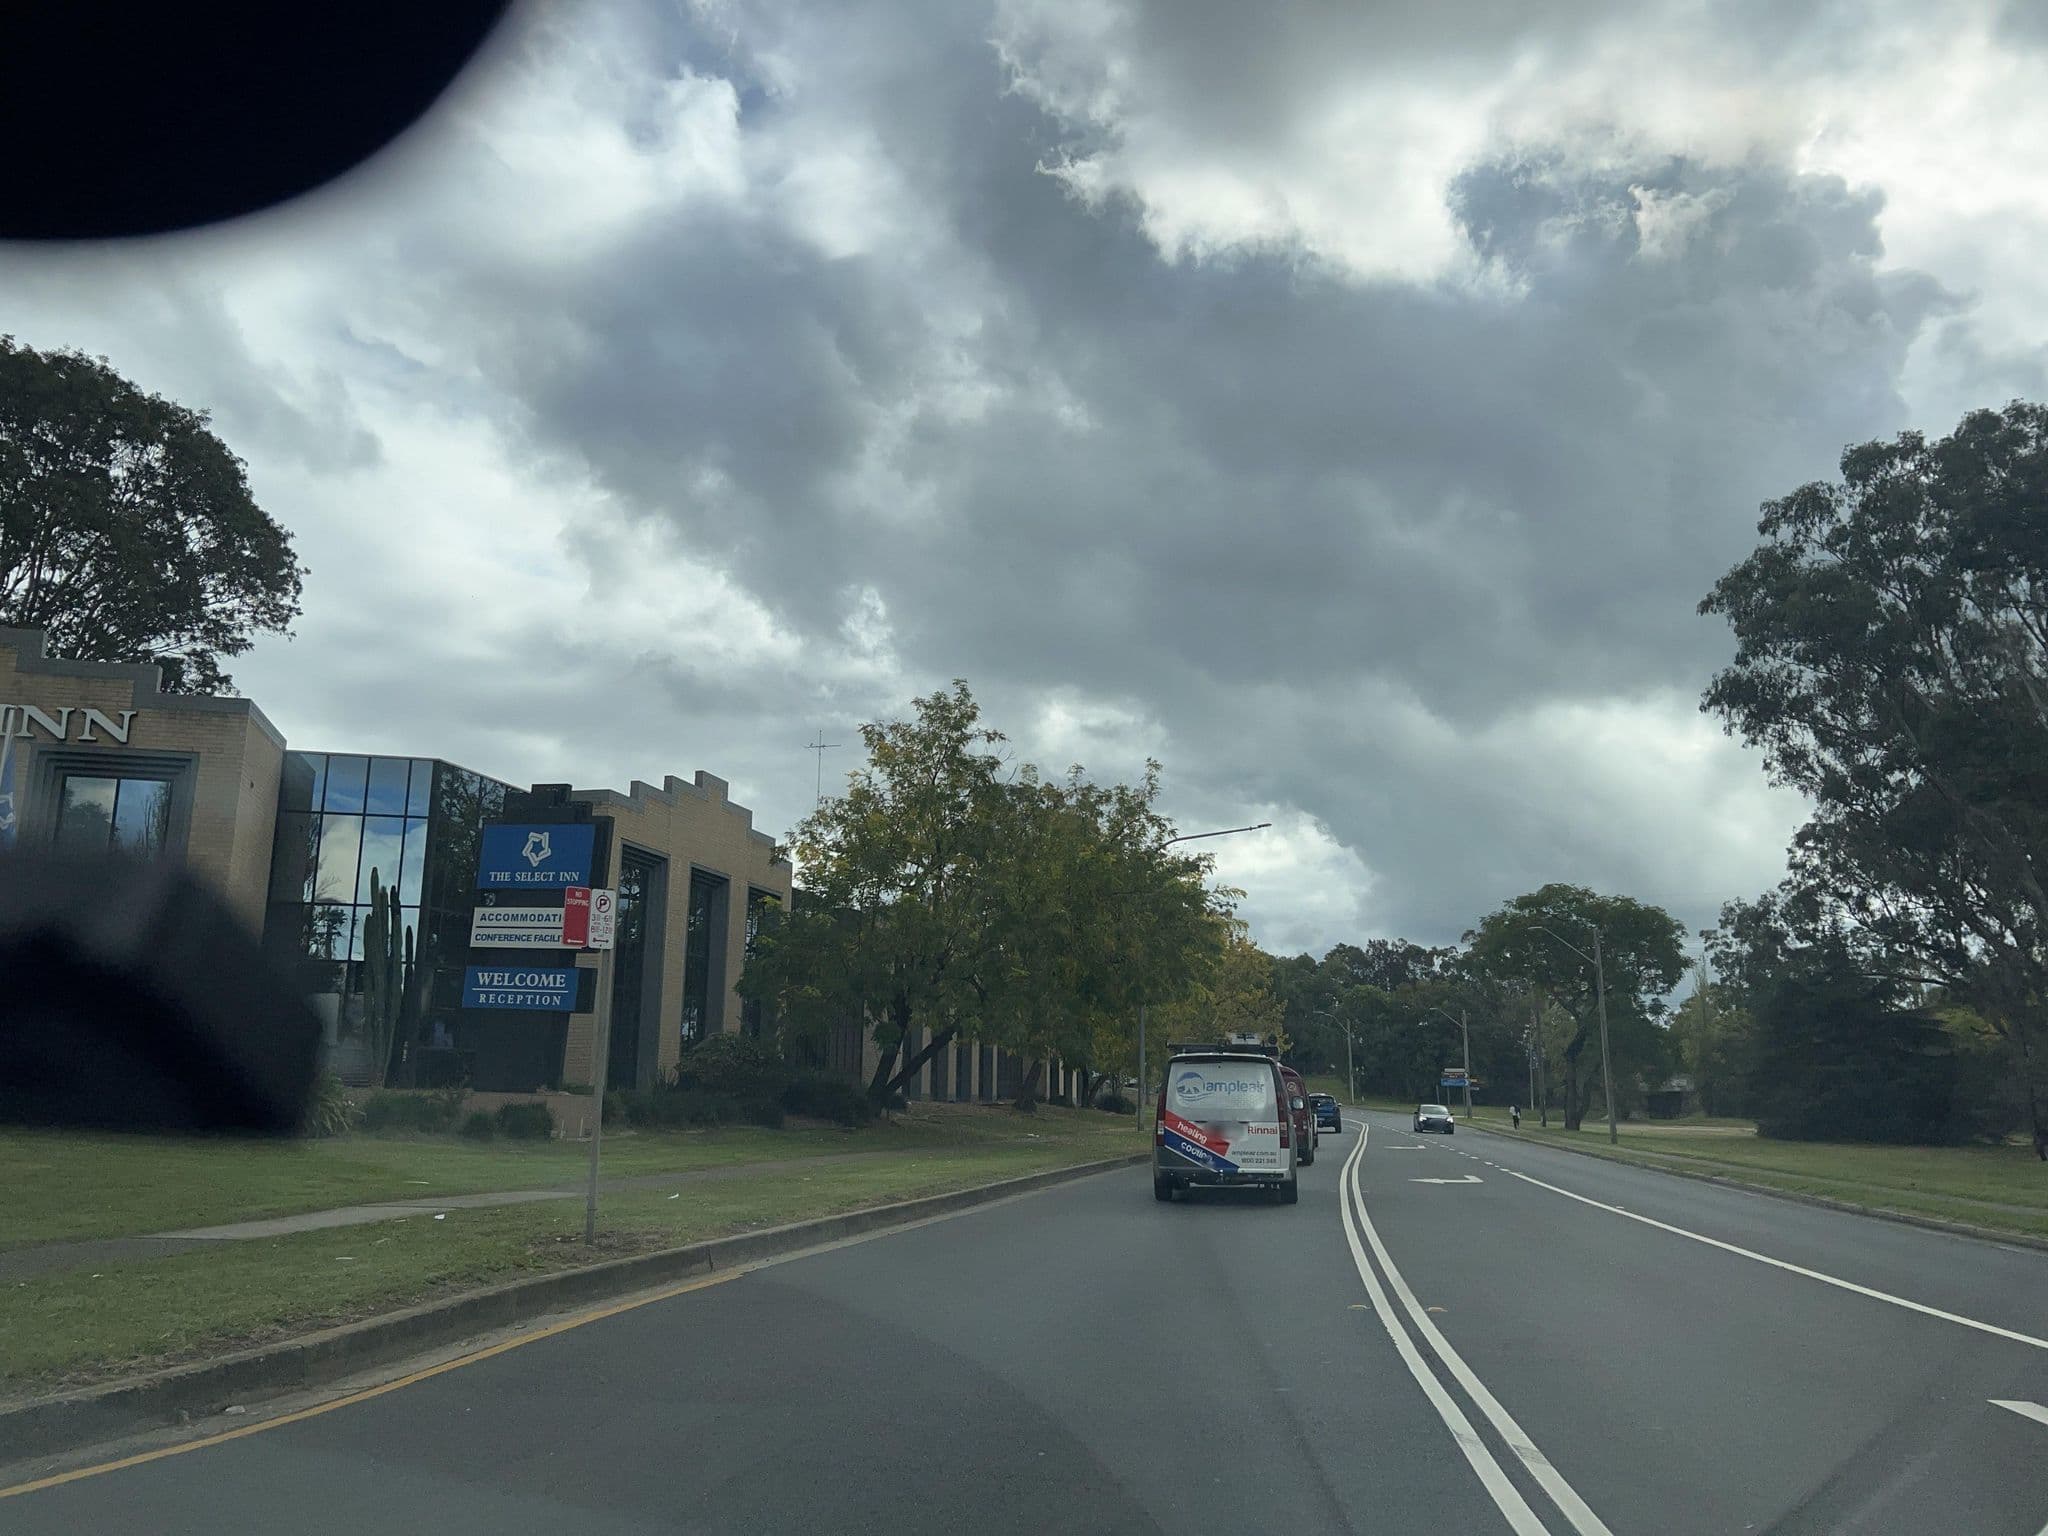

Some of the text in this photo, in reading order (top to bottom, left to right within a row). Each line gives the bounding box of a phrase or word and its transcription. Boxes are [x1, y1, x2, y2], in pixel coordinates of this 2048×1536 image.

[489, 871, 580, 882] THE SELECT INN
[480, 913, 562, 923] ACCOMMODATI
[475, 933, 563, 944] CONFERENCE FACILI
[477, 972, 566, 988] WELCOME
[479, 993, 561, 1006] RECEPTION
[1177, 1121, 1207, 1144] heating
[1247, 1126, 1278, 1135] Rinnai
